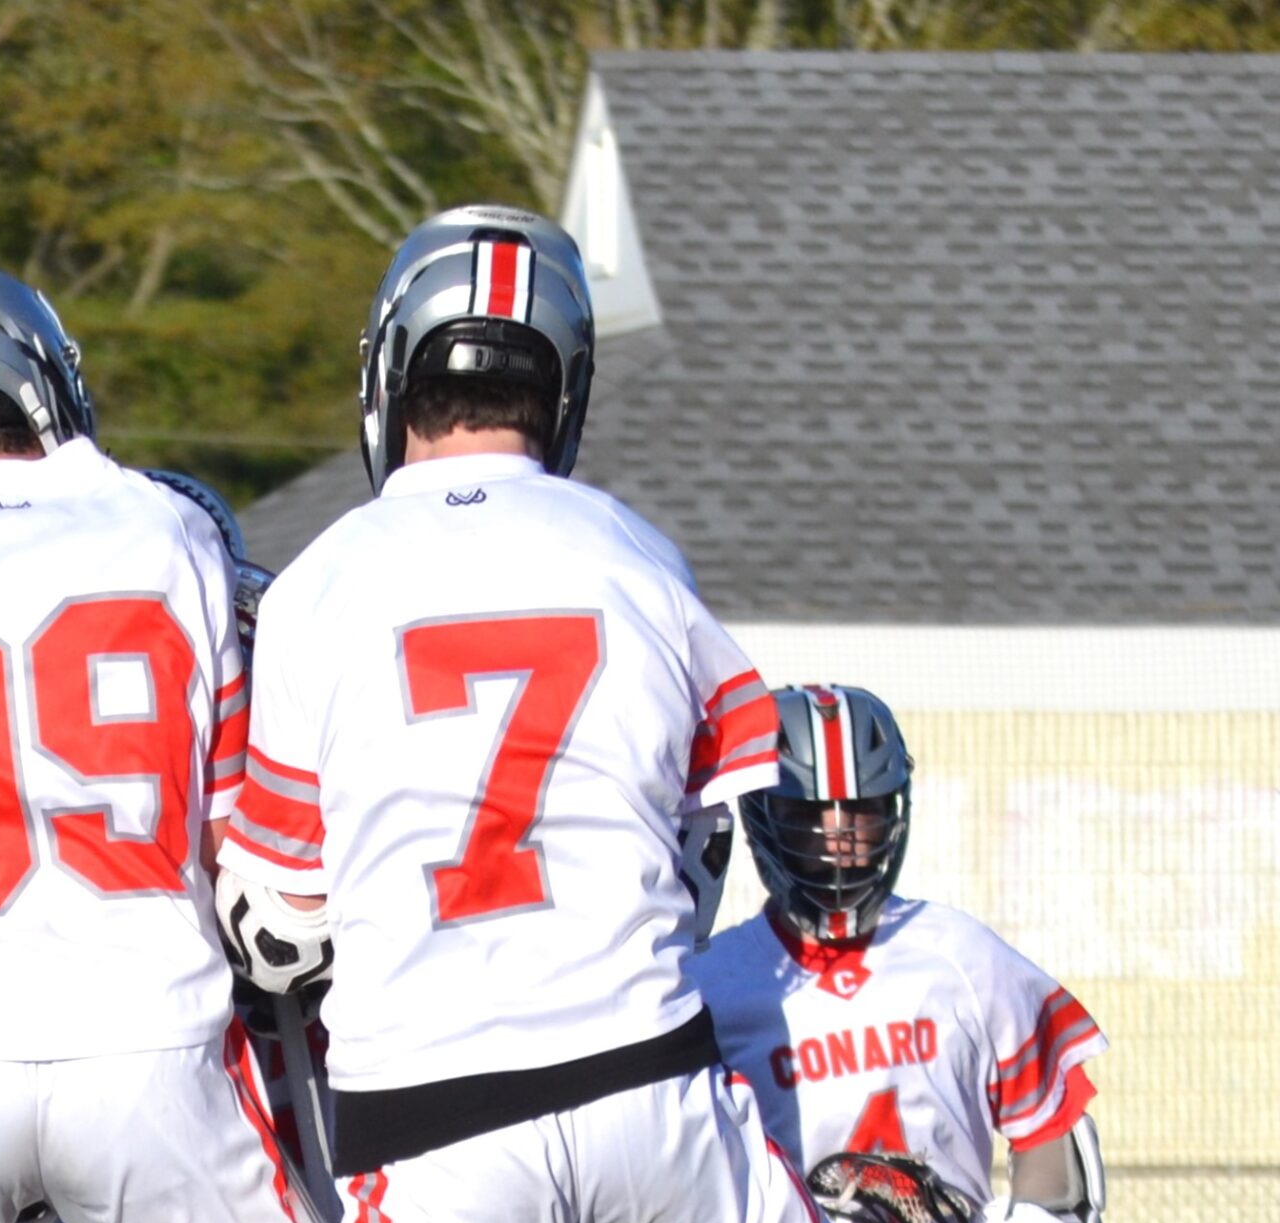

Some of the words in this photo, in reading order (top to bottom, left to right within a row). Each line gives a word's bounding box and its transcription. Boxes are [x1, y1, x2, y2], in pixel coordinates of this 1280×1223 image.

[392, 608, 608, 931] 7
[833, 970, 858, 995] C
[770, 1017, 938, 1089] CONARD
